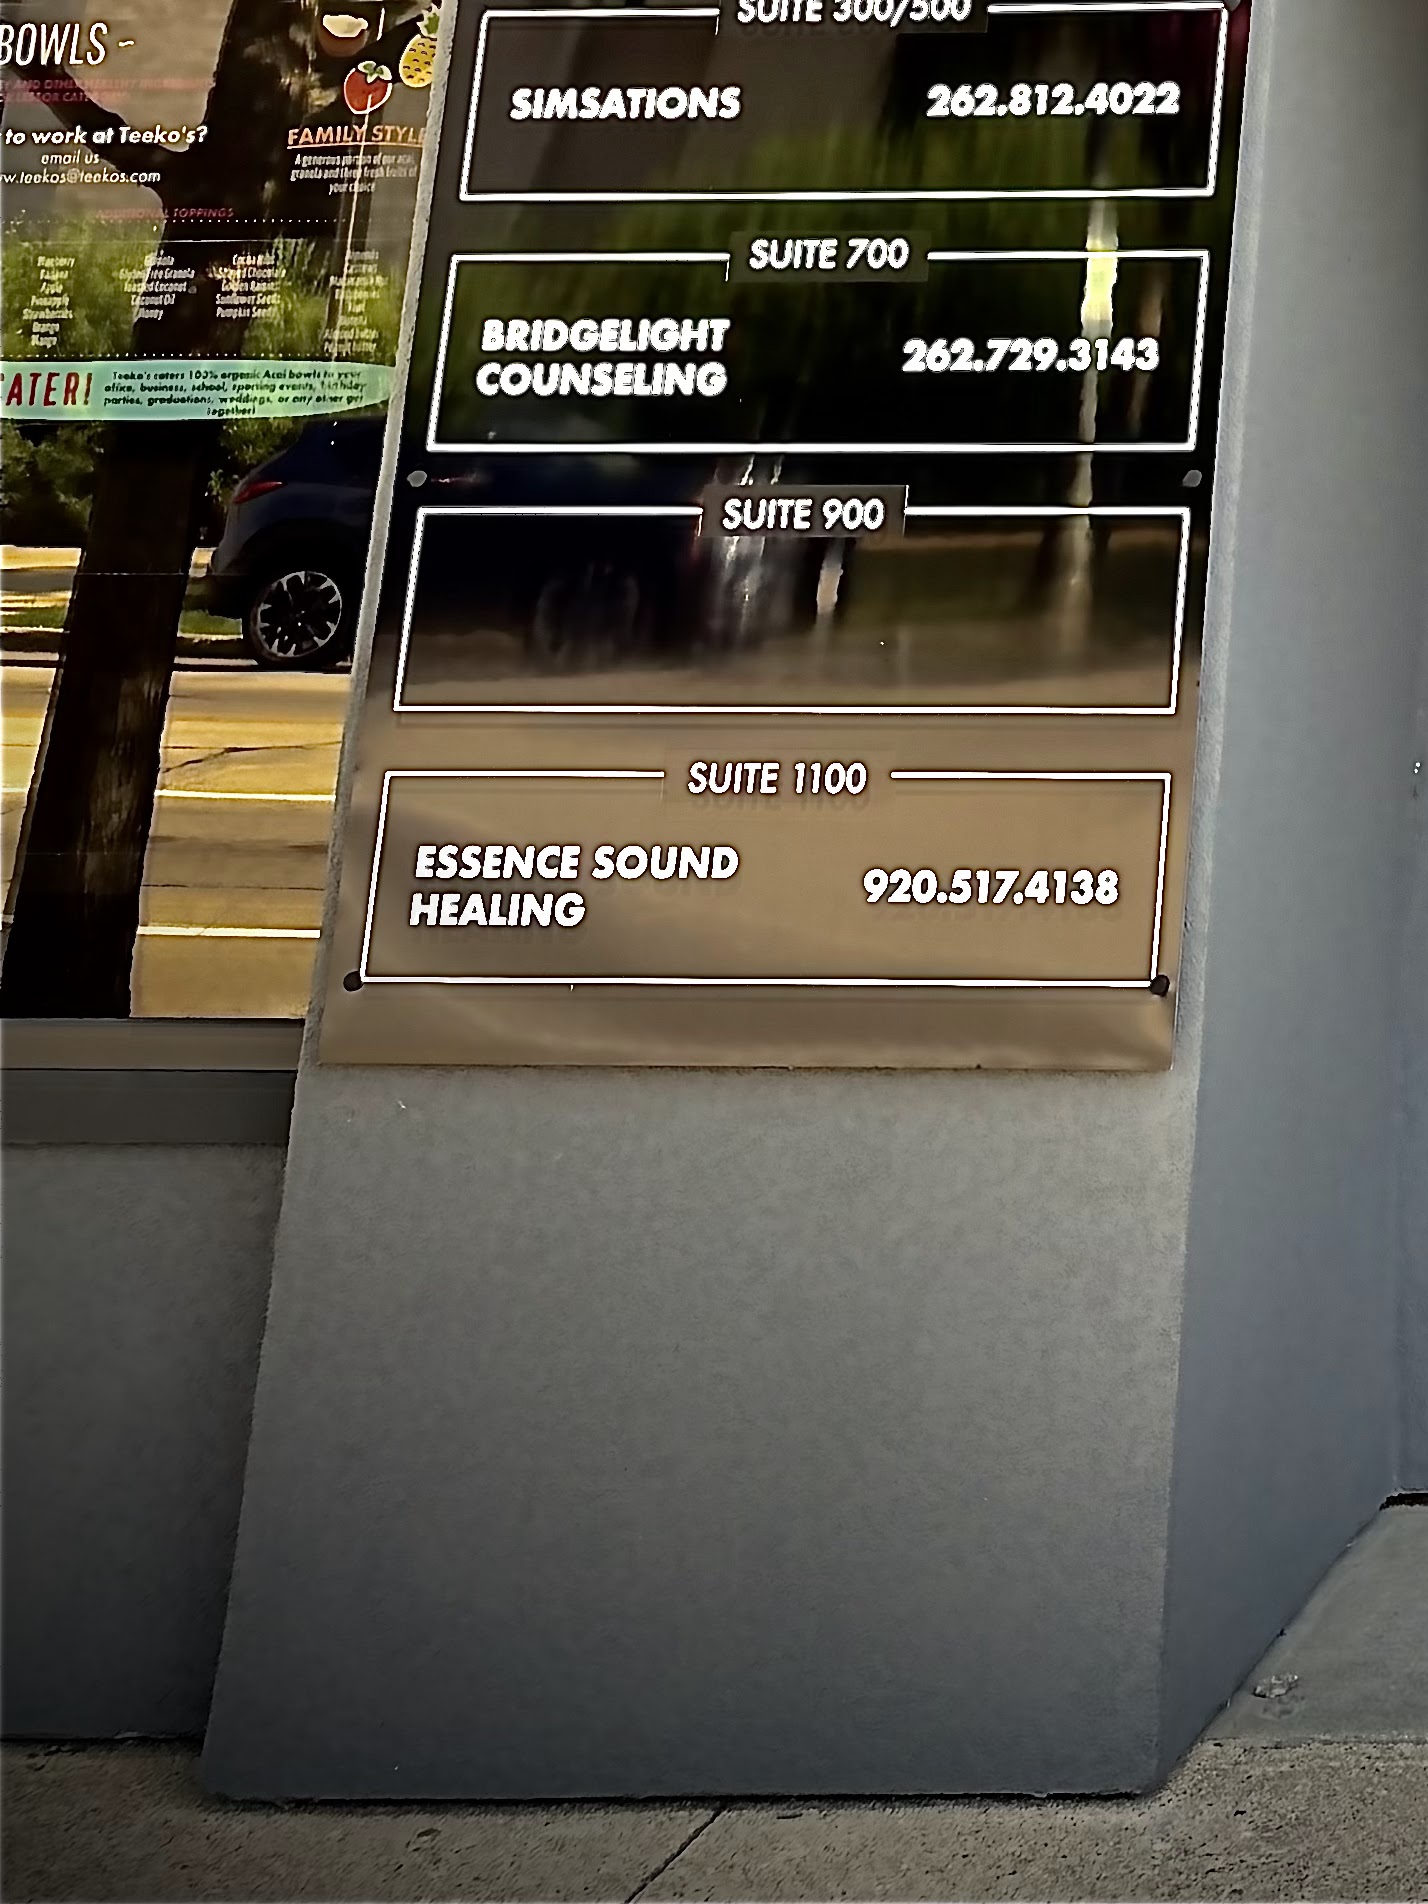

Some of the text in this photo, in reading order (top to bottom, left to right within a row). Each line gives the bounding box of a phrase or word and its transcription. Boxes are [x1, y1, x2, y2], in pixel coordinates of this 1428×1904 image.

[0, 22, 108, 66] BOWLS
[509, 81, 1181, 120] SIMSATIONS 262.812.4022
[6, 124, 208, 145] to work at Teeko's?
[288, 125, 368, 145] FAMILY
[41, 149, 100, 165] email us
[173, 207, 234, 218] TOPPINGS
[749, 238, 909, 270] SUITE 700
[481, 318, 731, 352] BRIDGELIGHT
[153, 371, 185, 380] caters
[476, 336, 1161, 397] COUNSELING 262.729.3143
[0, 372, 93, 406] ATER!
[103, 395, 143, 406] parties,
[147, 393, 214, 406] graduations,
[722, 498, 884, 530] SUITE 900
[687, 761, 867, 795] SUITE 1100
[415, 844, 739, 880] ESSENCE SOUND
[409, 868, 1119, 927] HEALING 920.517.4138
